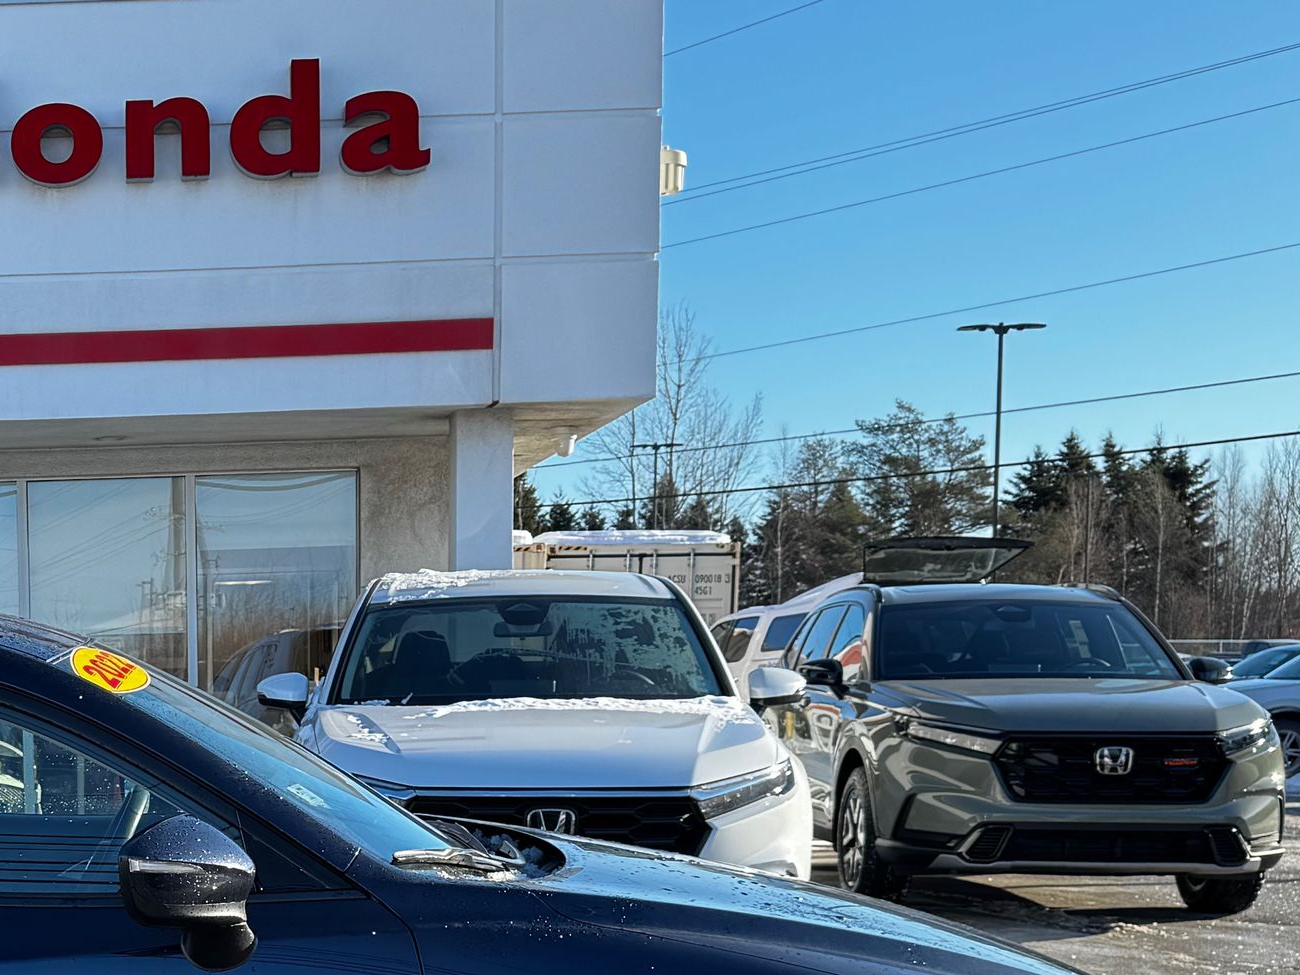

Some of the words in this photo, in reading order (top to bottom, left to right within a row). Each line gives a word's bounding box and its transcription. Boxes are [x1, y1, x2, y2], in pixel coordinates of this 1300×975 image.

[694, 574, 722, 584] 090018
[694, 586, 713, 595] 45G1
[83, 651, 137, 689] 2022
